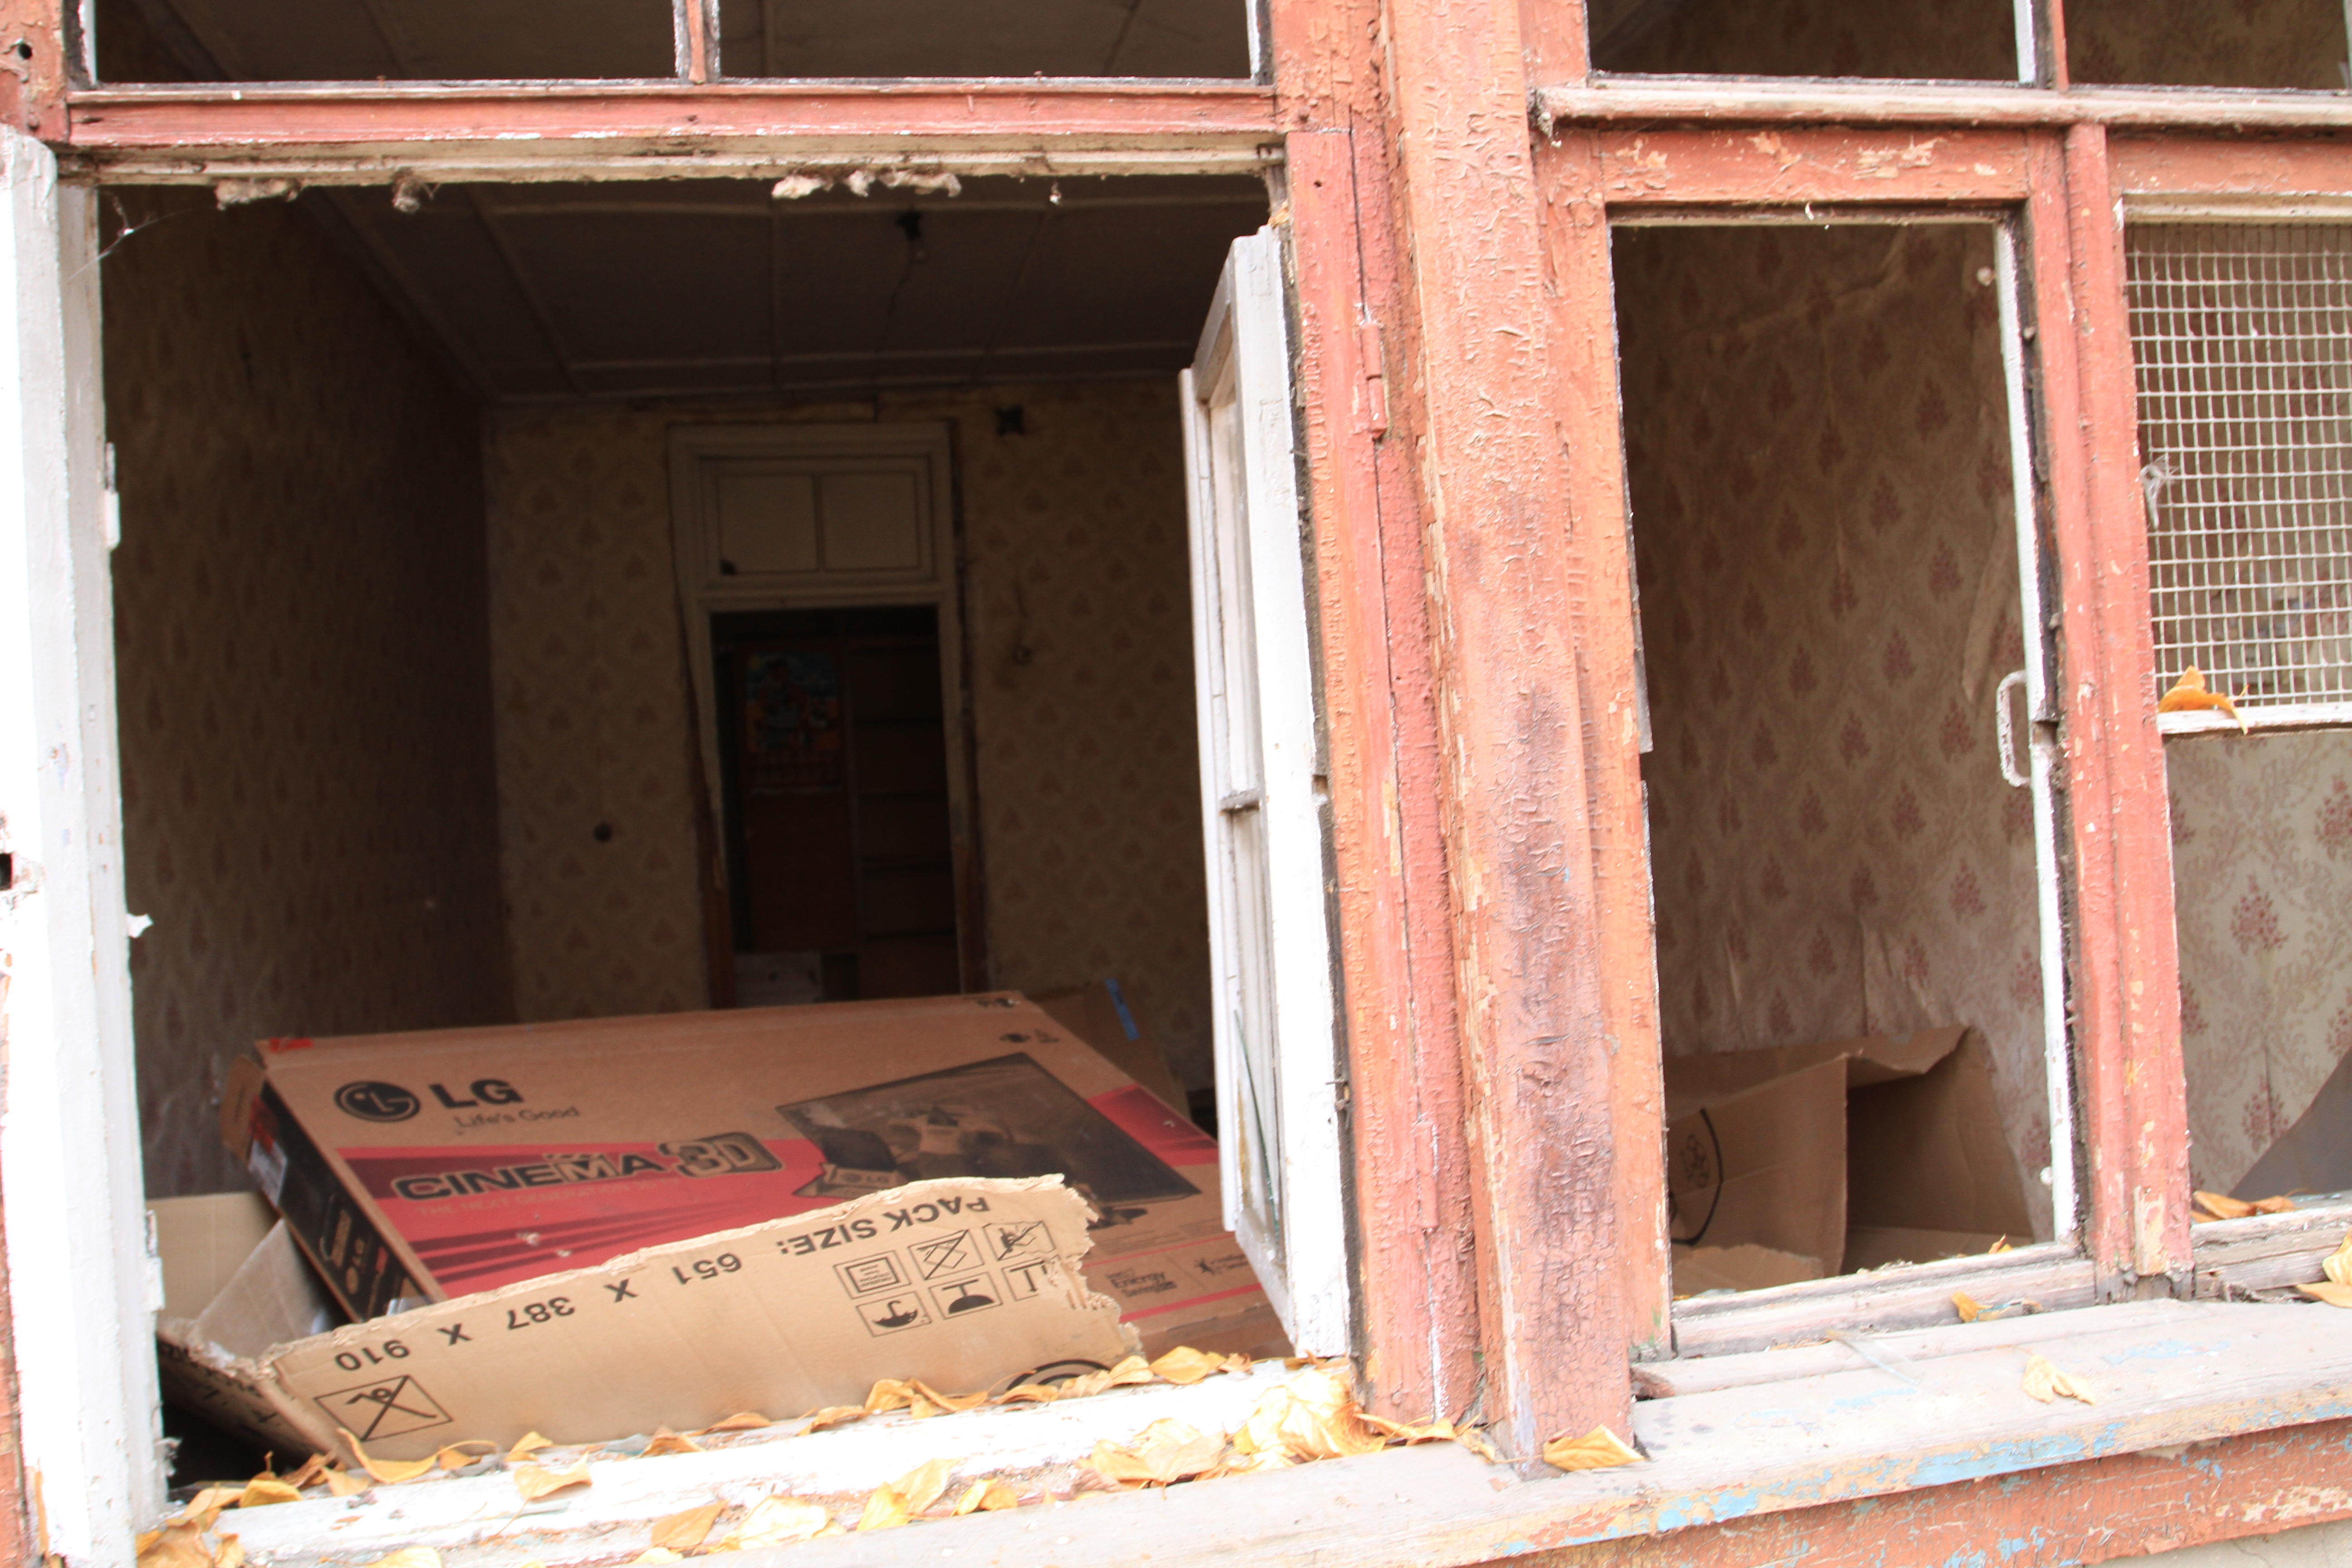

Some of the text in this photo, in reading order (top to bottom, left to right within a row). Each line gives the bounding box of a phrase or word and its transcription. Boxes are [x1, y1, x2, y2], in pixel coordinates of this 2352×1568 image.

[430, 1079, 524, 1107] LG
[518, 1106, 580, 1121] Good
[393, 1136, 762, 1201] CINEMA 3D
[883, 1196, 990, 1233] PACK
[776, 1219, 878, 1255] SIZE:
[672, 1252, 742, 1285] 651
[507, 1296, 575, 1330] 387
[334, 1339, 410, 1371] 910
